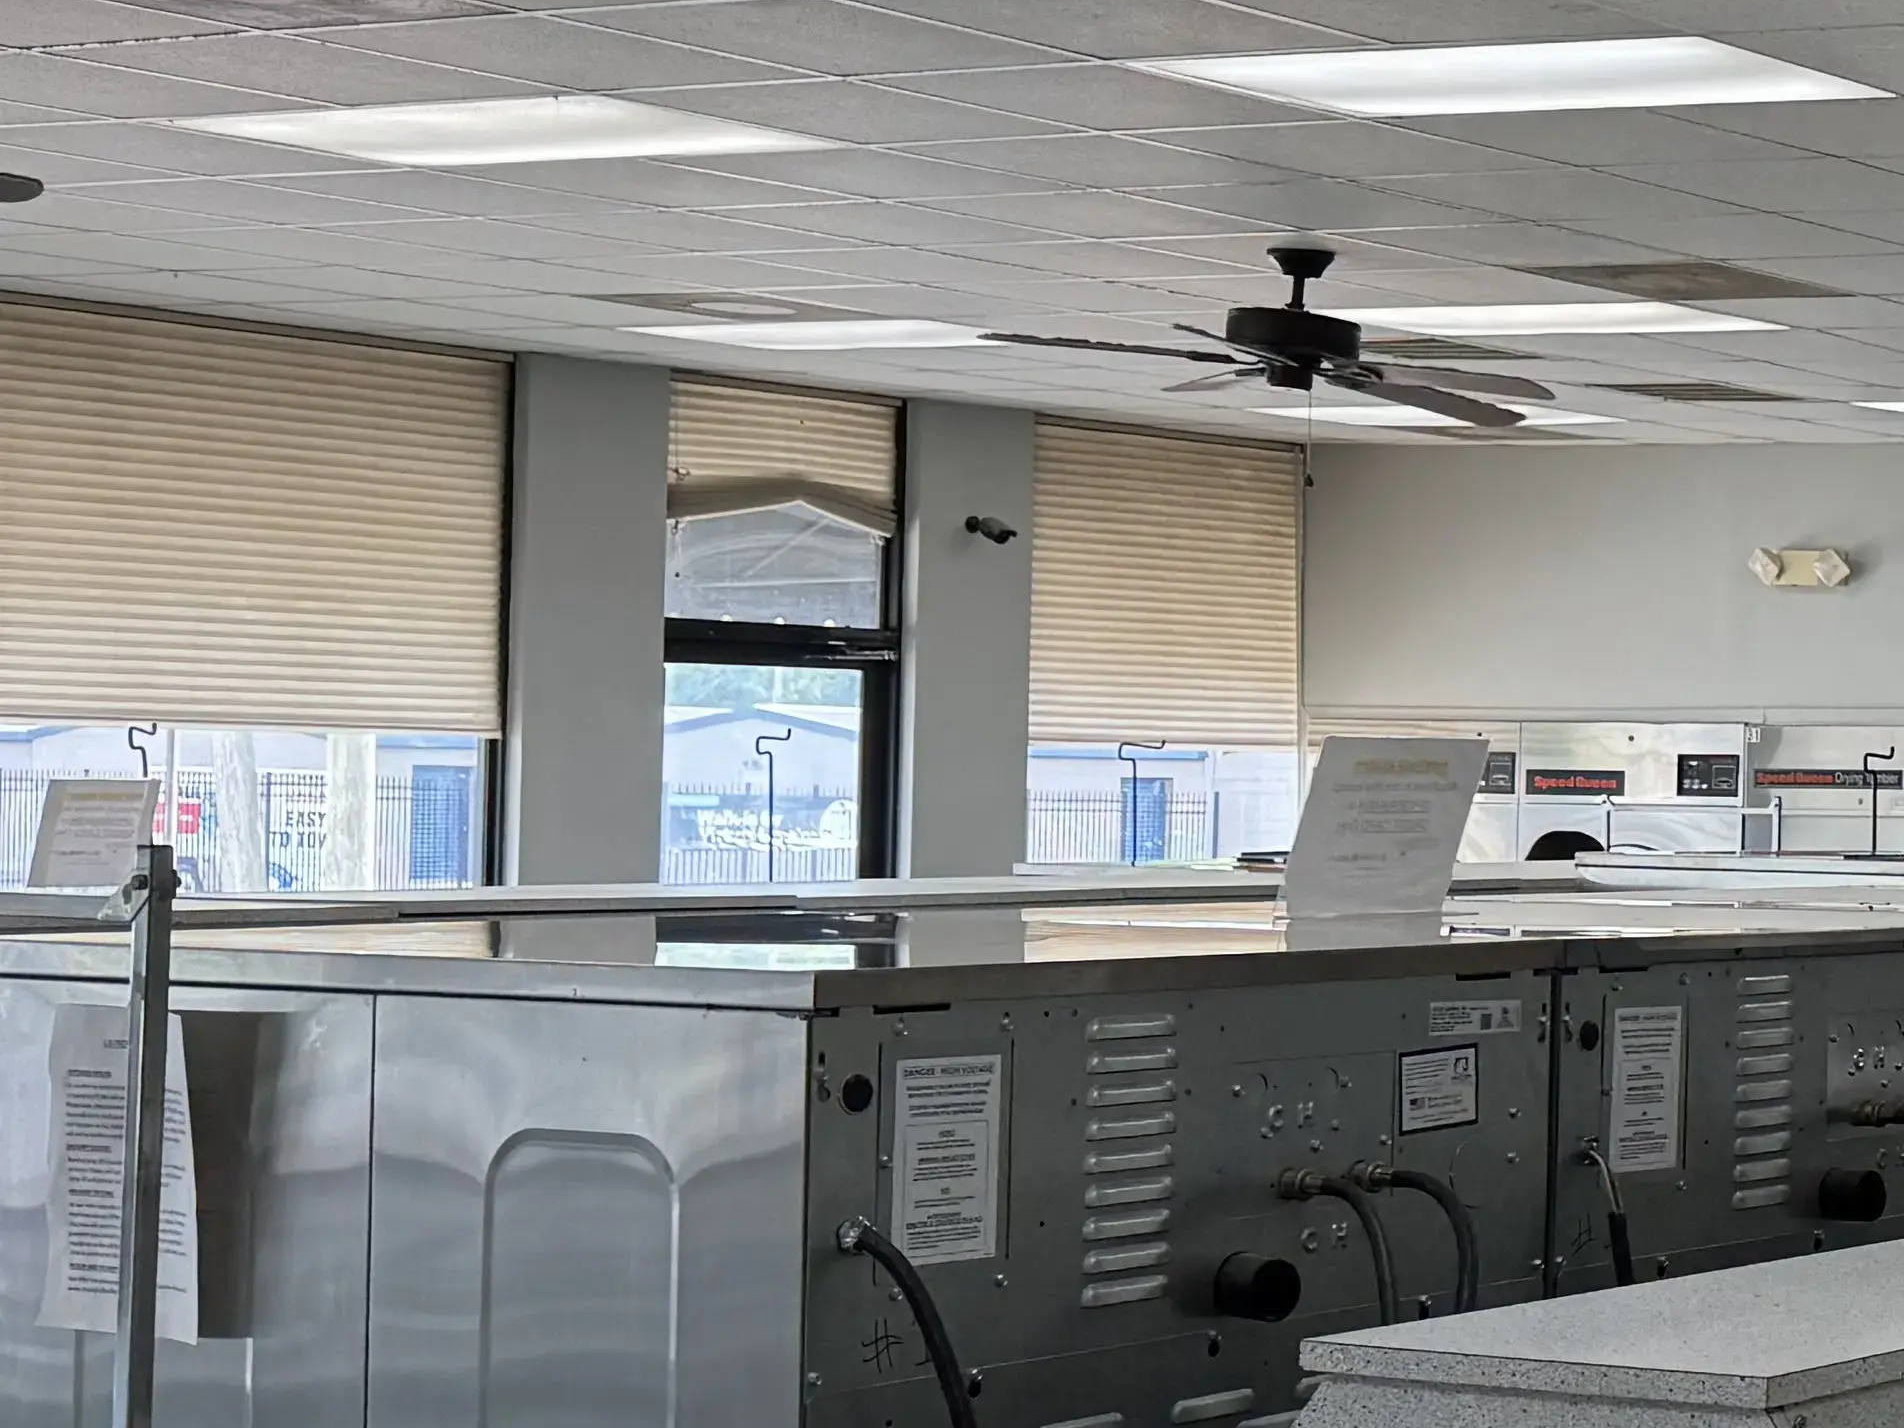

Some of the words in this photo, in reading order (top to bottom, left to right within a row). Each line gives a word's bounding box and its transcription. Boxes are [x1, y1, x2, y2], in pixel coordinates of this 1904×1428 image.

[1534, 776, 1574, 790] Speed
[1576, 776, 1617, 789] Queen
[286, 811, 327, 828] EASY
